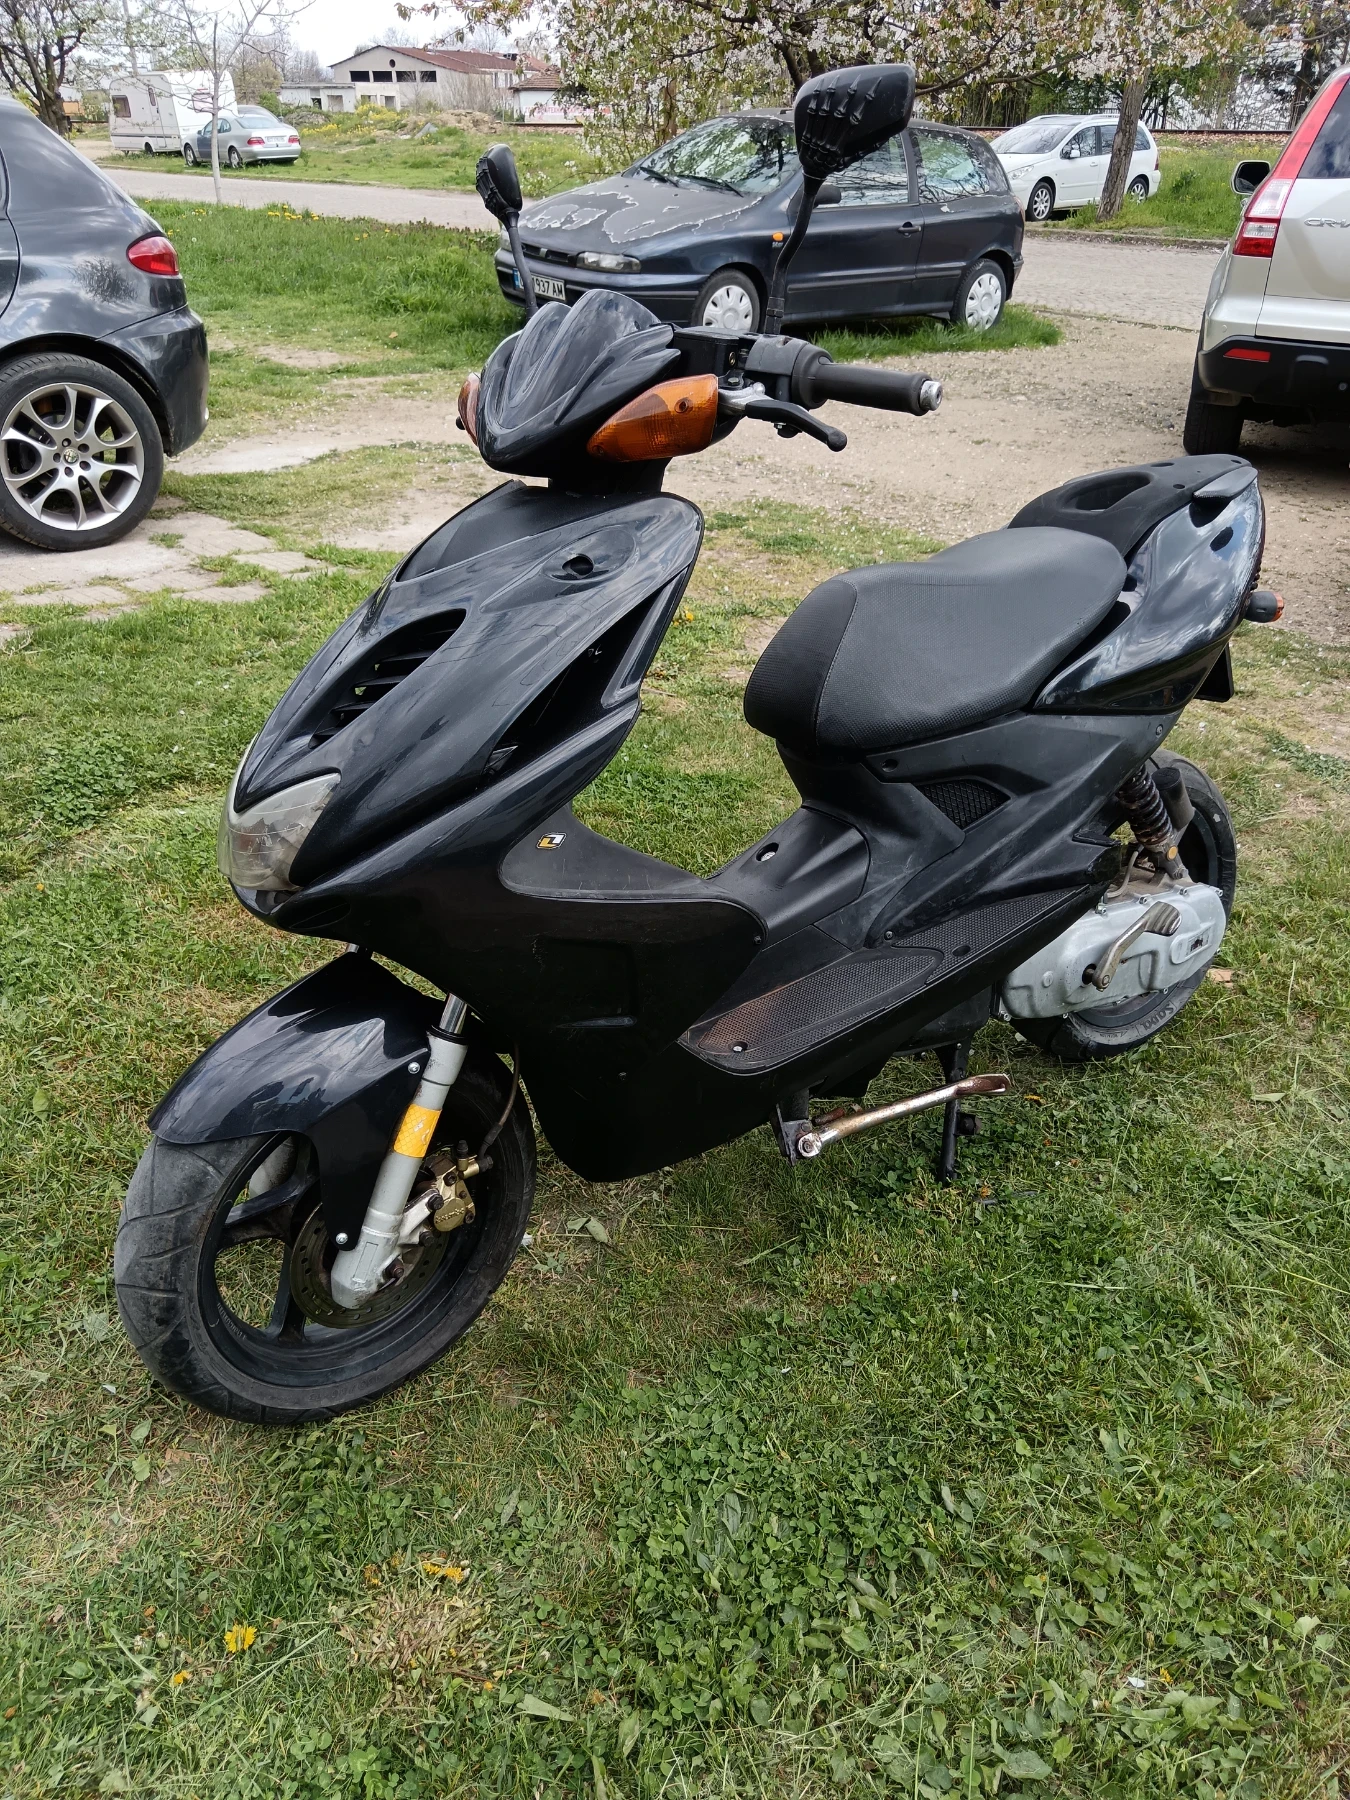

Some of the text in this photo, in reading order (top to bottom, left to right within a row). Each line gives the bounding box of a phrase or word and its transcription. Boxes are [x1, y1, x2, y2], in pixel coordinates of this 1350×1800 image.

[531, 277, 550, 294] 1937
[552, 282, 564, 298] AM
[1141, 1002, 1175, 1030] Sava
